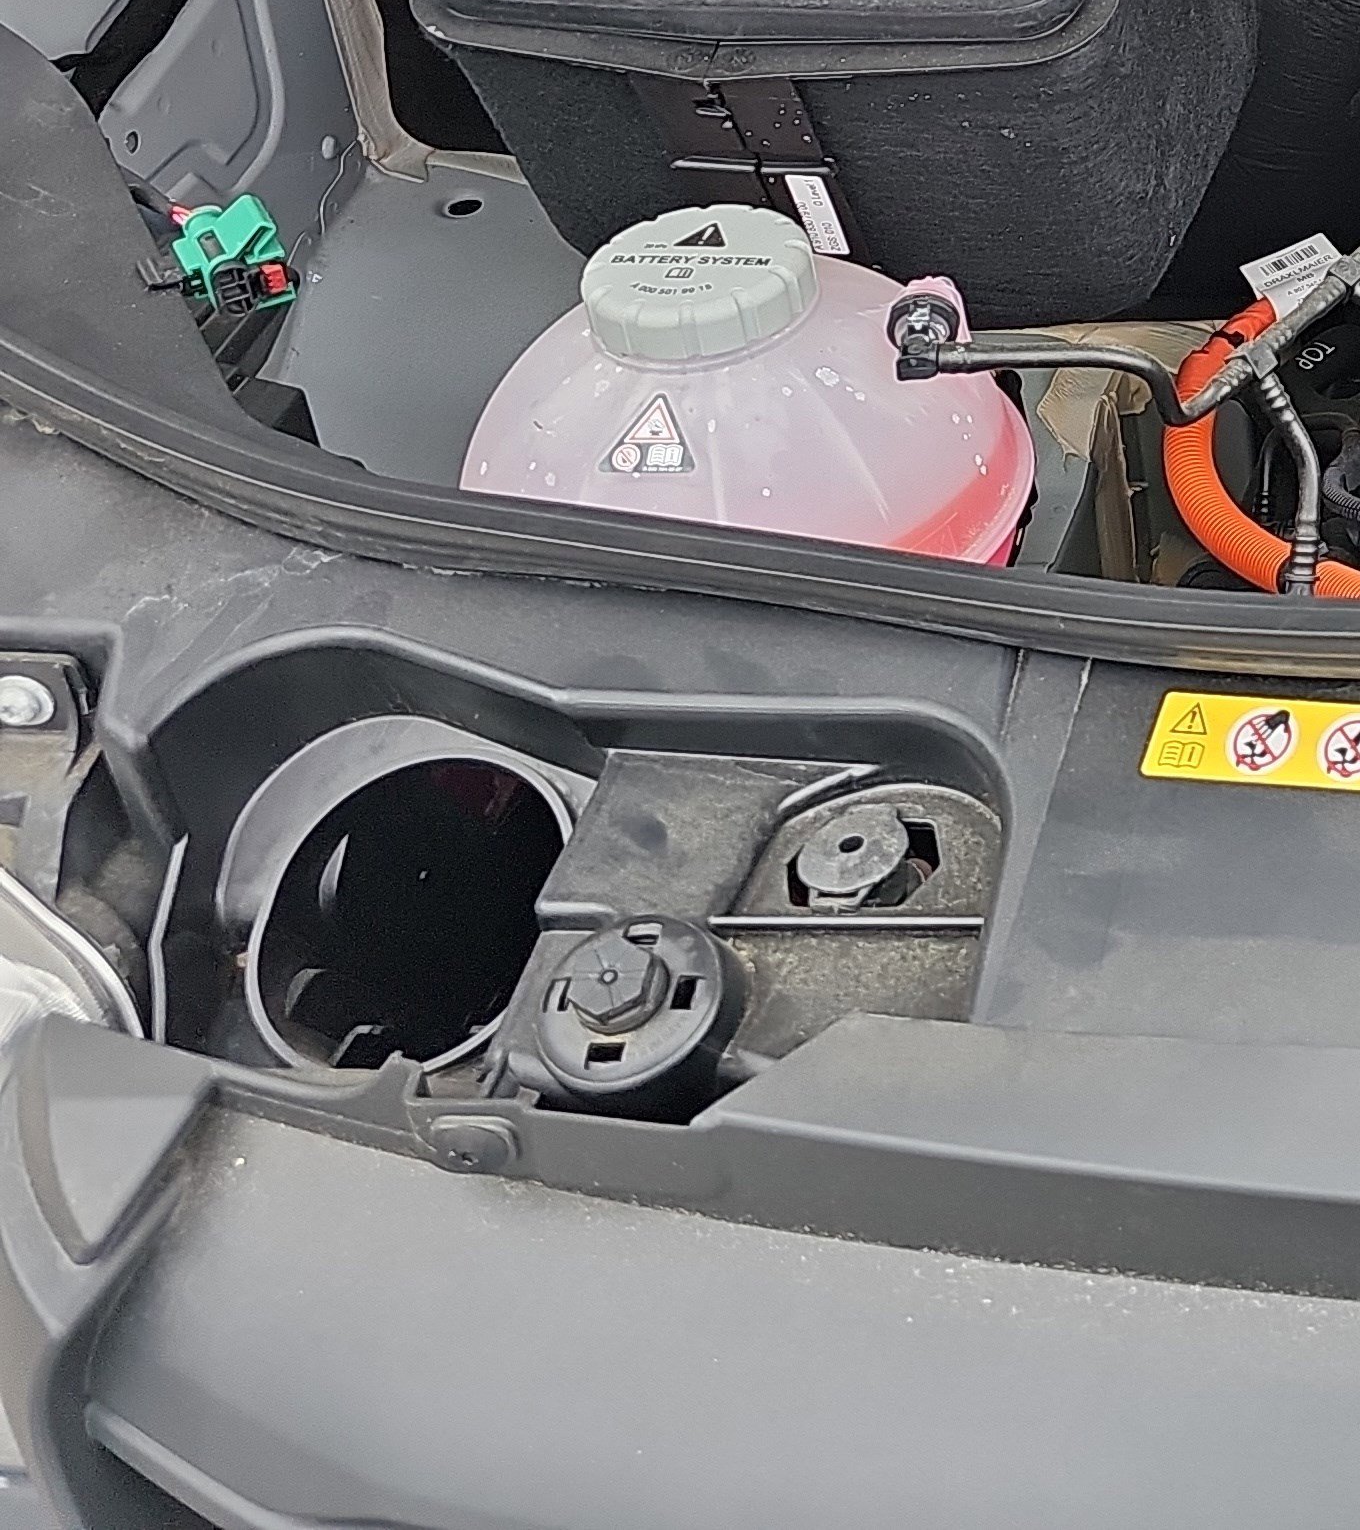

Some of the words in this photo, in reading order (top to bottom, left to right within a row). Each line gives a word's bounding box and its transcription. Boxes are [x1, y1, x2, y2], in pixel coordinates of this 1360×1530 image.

[610, 255, 696, 265] BATTERY
[697, 255, 772, 267] SYSTEM
[1296, 272, 1315, 283] MB
[638, 285, 657, 294] 000
[1294, 341, 1336, 370] TOP
